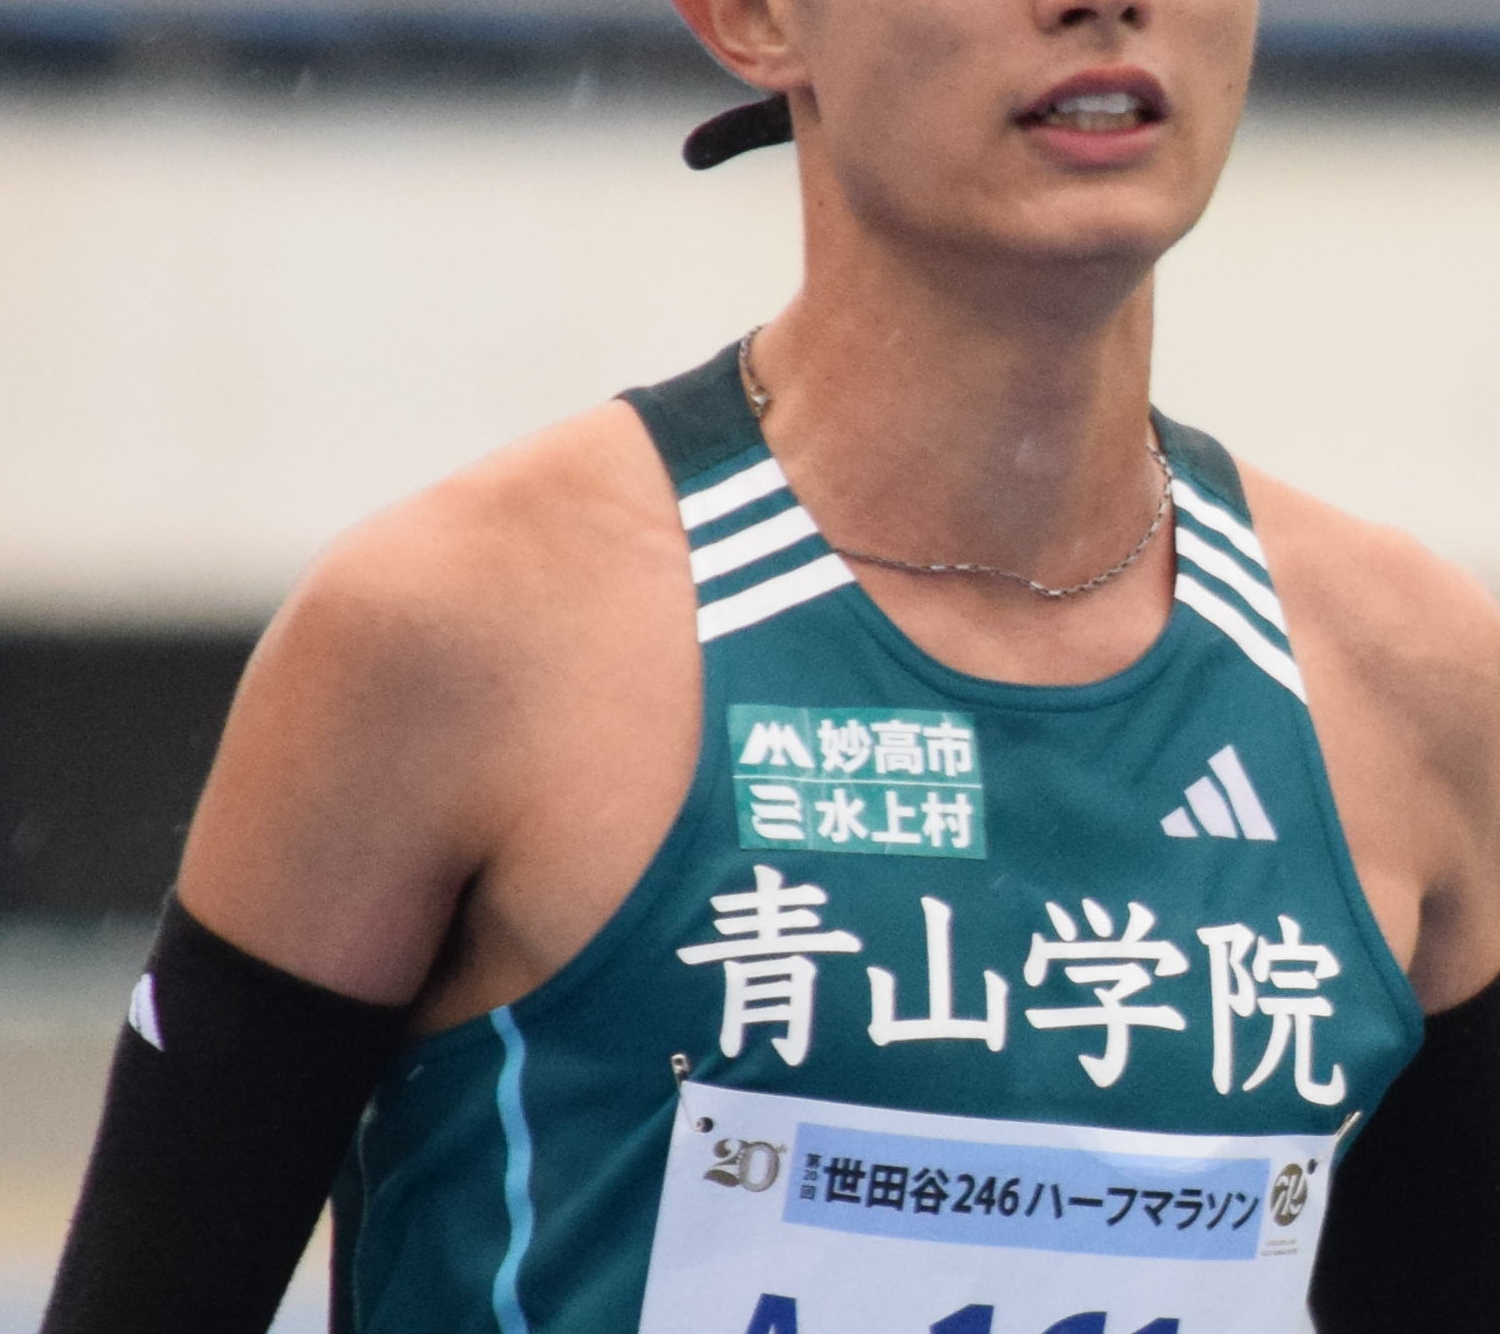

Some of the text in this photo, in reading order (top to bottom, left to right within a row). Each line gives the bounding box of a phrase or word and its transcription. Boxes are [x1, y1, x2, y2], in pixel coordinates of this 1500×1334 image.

[816, 718, 974, 778] 妙高市
[814, 788, 973, 849] 水上村
[676, 864, 1348, 1107] 青山学院
[823, 1156, 1260, 1231] 世田谷246ハーフマラソン
